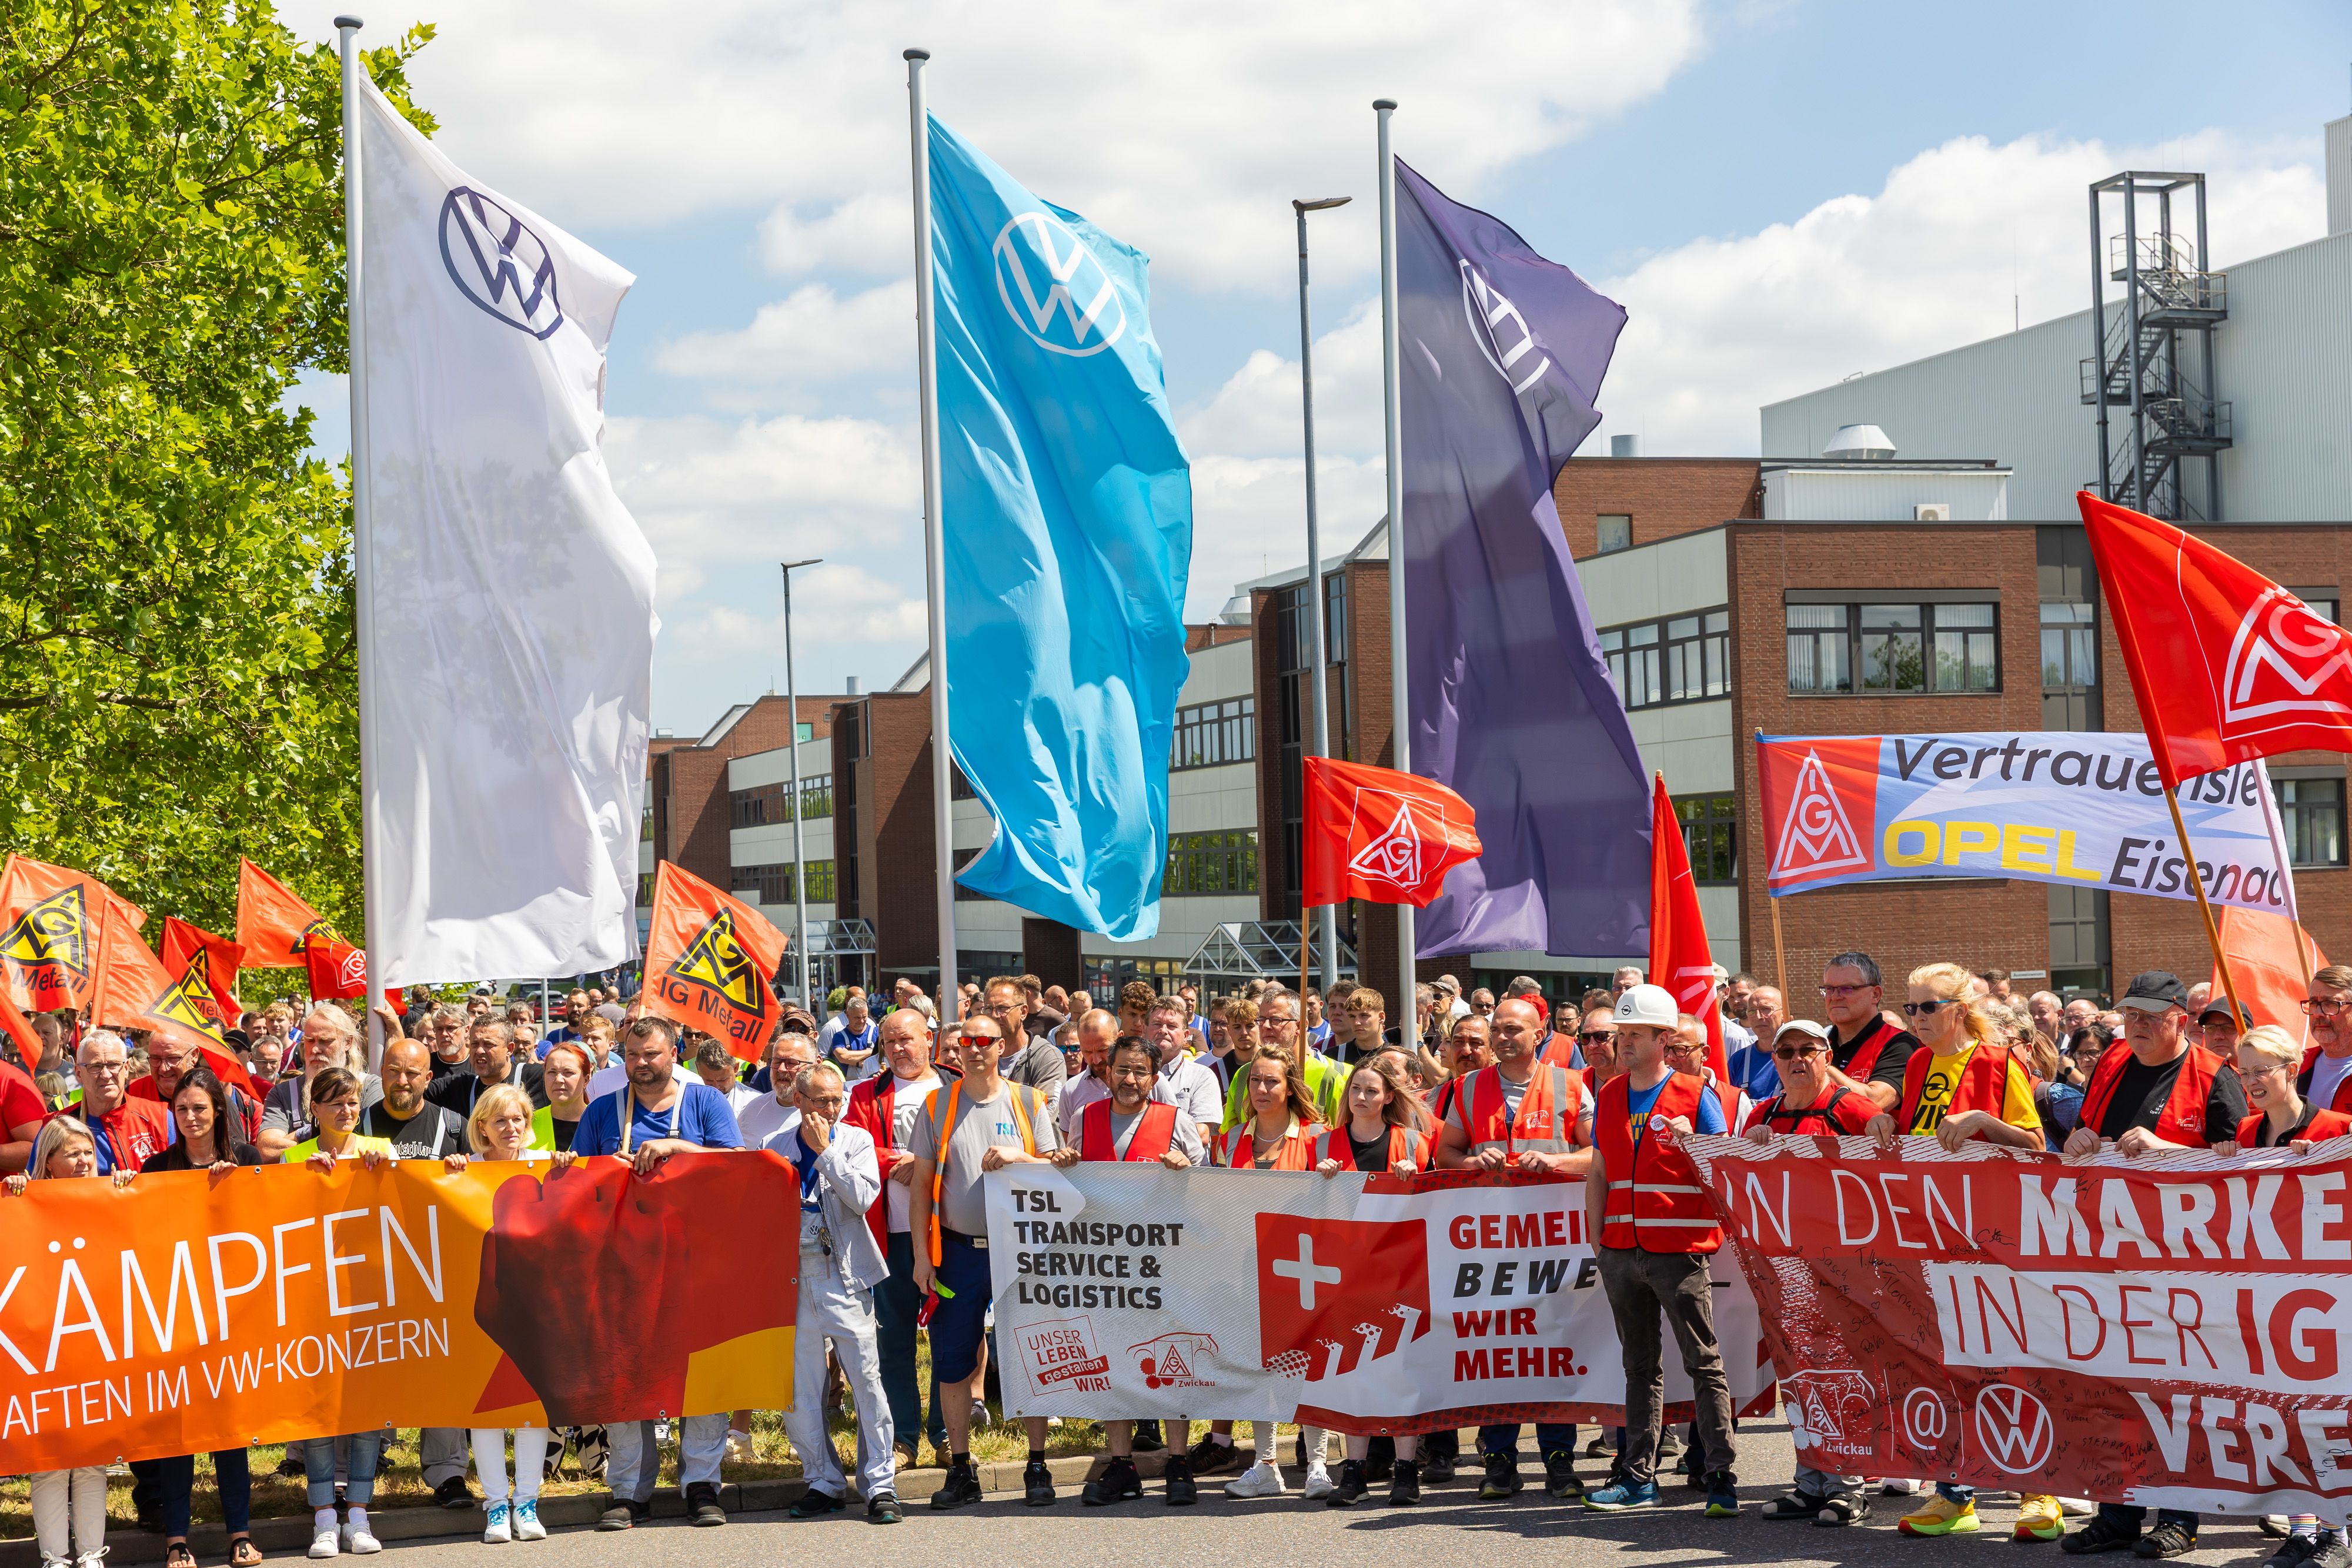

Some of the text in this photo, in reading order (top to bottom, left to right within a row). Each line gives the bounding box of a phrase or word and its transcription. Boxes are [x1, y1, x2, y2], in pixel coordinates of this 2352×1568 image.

[993, 212, 1126, 357] VW
[1883, 820, 2286, 907] OPEL Eisenac
[12, 967, 88, 994] Metall
[659, 976, 763, 1044] IG Metall
[995, 1122, 1015, 1136] TSL
[1011, 1189, 1061, 1213] TSL
[1830, 1169, 1975, 1250] DEN
[2019, 1171, 2351, 1261] MARKE
[1013, 1221, 1184, 1246] TRANSPORT
[1448, 1209, 1590, 1251] GEMEI
[1017, 1252, 1162, 1279] SERVICE &
[1018, 1282, 1162, 1310] LOGISTICS
[1452, 1308, 1538, 1339] WIR
[1948, 1275, 2029, 1355] IN
[2052, 1285, 2217, 1370] DER
[2236, 1288, 2338, 1382] IG
[1027, 1330, 1083, 1350] UNSER
[1036, 1345, 1088, 1366] LEBEN
[1454, 1347, 1589, 1383] MEHR.
[2, 1317, 450, 1440] AFTEN IM VW-KONZERN
[1044, 1359, 1104, 1385] gestalten
[1074, 1376, 1112, 1392] WIR!
[1178, 1379, 1215, 1388] Zwickau
[1903, 1386, 1947, 1450] @
[1976, 1384, 2054, 1475] VW
[1826, 1440, 1872, 1455] Zwickau
[2128, 1391, 2352, 1492] VERE
